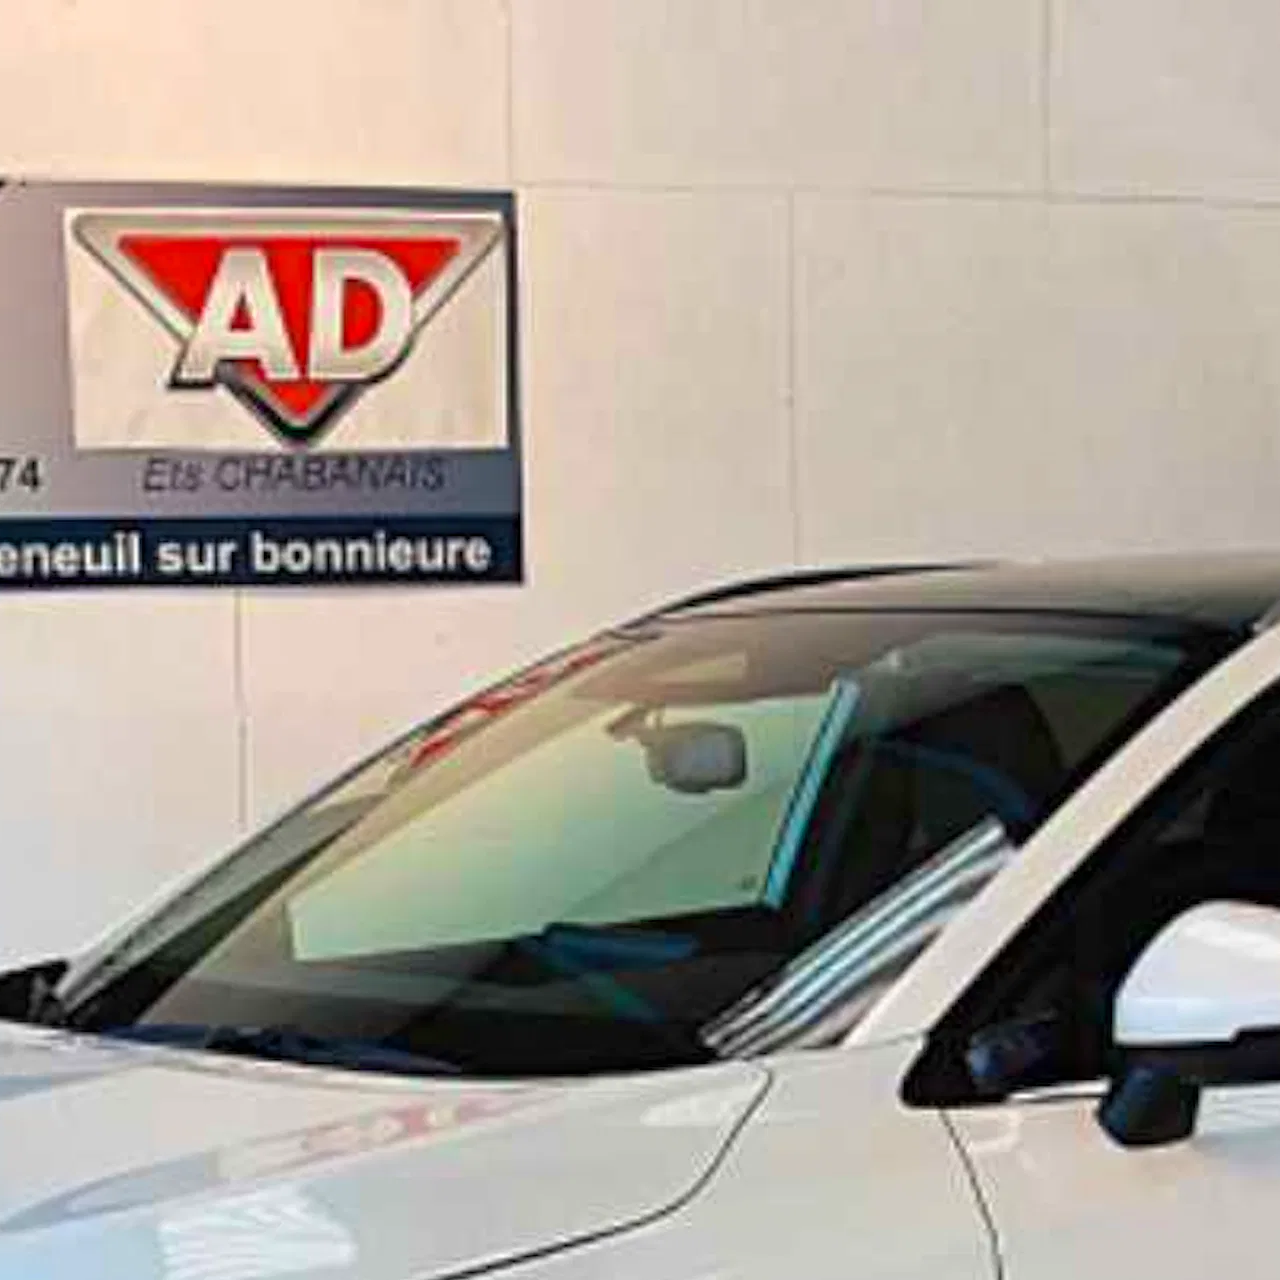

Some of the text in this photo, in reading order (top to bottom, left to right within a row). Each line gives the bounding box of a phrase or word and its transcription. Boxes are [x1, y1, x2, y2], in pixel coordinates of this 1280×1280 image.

[178, 246, 417, 384] AD
[142, 455, 447, 492] Ets CHABANAIS
[157, 538, 239, 574] sur
[250, 529, 493, 574] bonnieure
